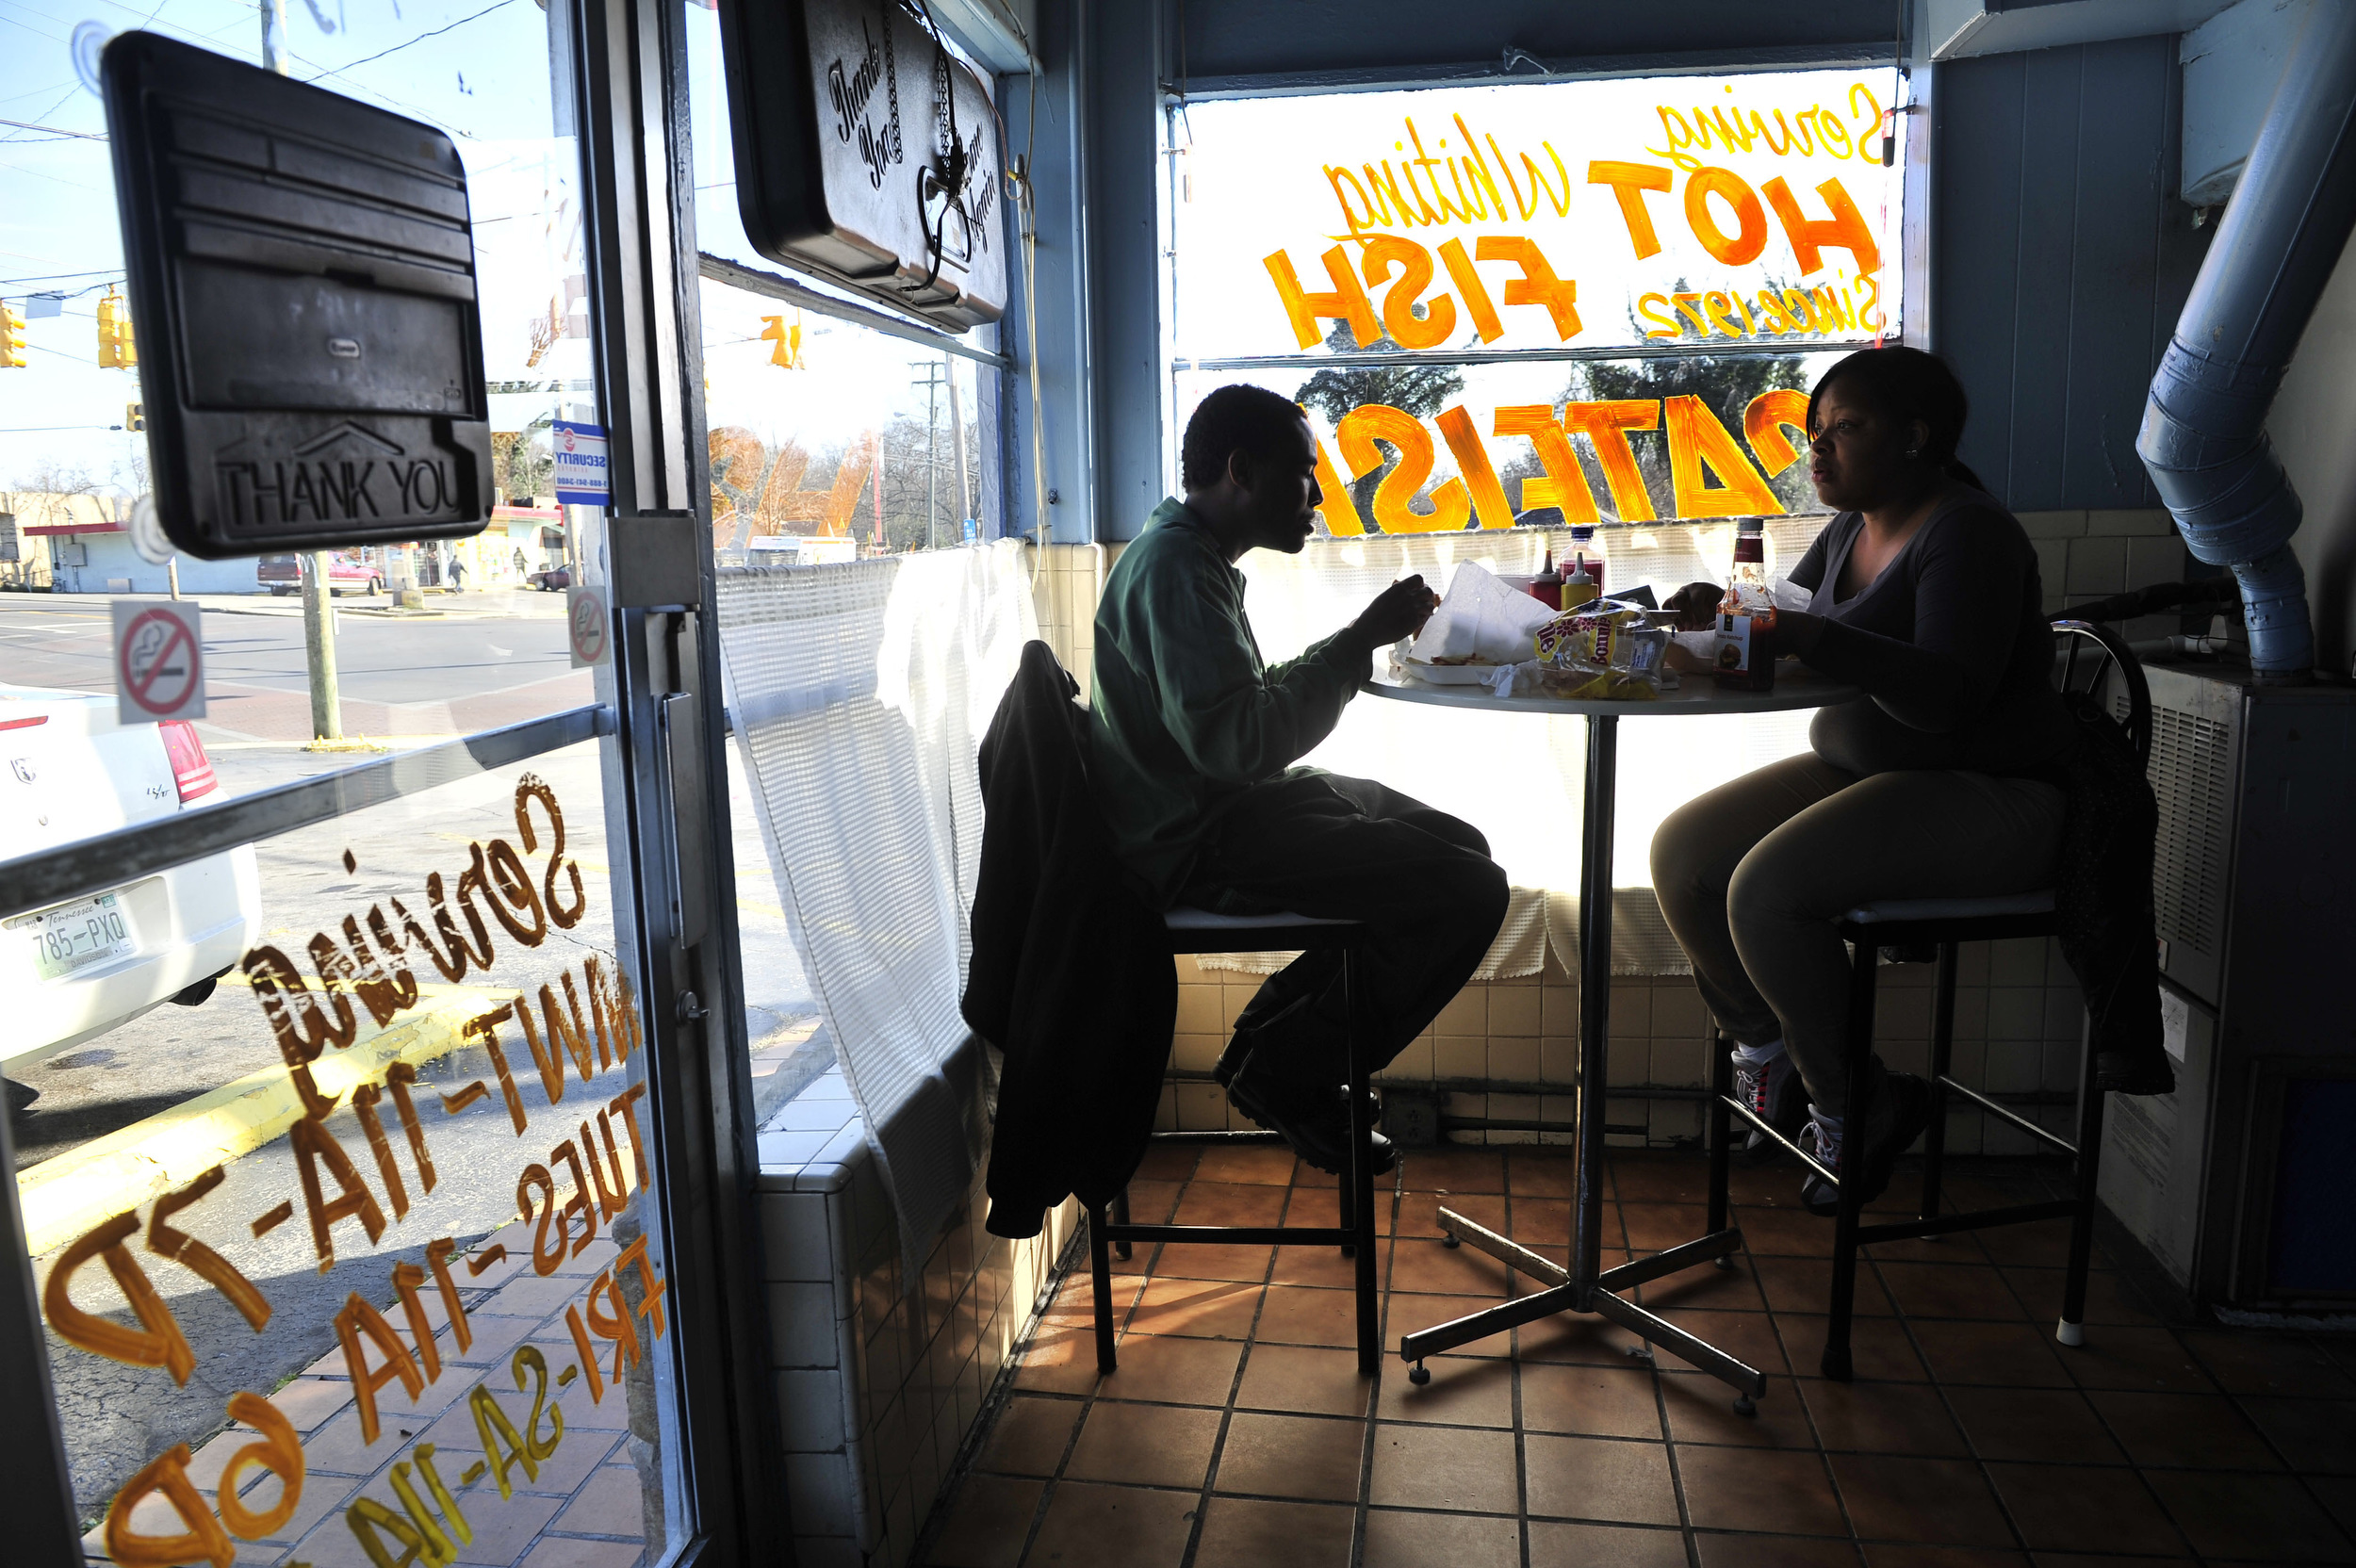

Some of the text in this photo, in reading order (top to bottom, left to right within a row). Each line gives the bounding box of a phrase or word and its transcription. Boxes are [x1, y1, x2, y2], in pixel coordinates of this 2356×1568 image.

[828, 16, 882, 144] Thank
[968, 169, 996, 255] Again
[218, 459, 460, 526] THANK YOU
[46, 905, 94, 927] Tennessee
